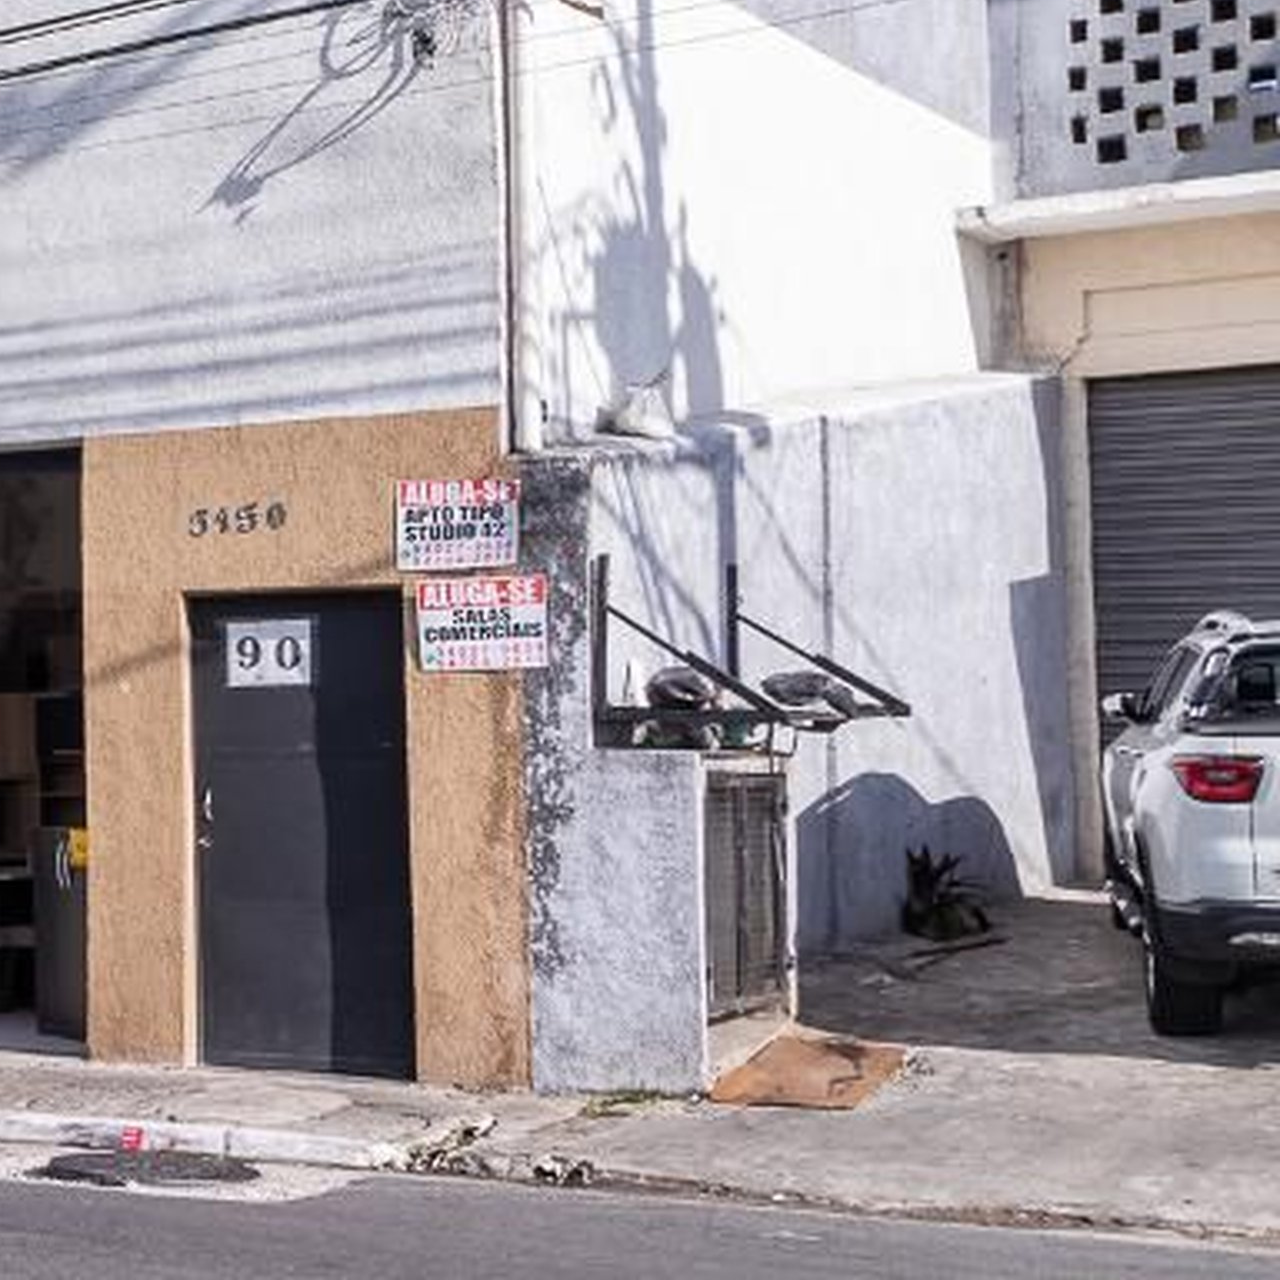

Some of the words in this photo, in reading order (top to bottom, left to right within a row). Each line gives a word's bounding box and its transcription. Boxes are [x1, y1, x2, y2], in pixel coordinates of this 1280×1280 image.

[404, 506, 454, 523] APTO
[458, 502, 504, 521] TIPO
[404, 523, 476, 542] STUDIO
[423, 576, 537, 609] ALUGA-SE
[452, 606, 511, 624] SALAS
[424, 621, 542, 643] COMERCIAIS
[237, 636, 301, 669] 90
